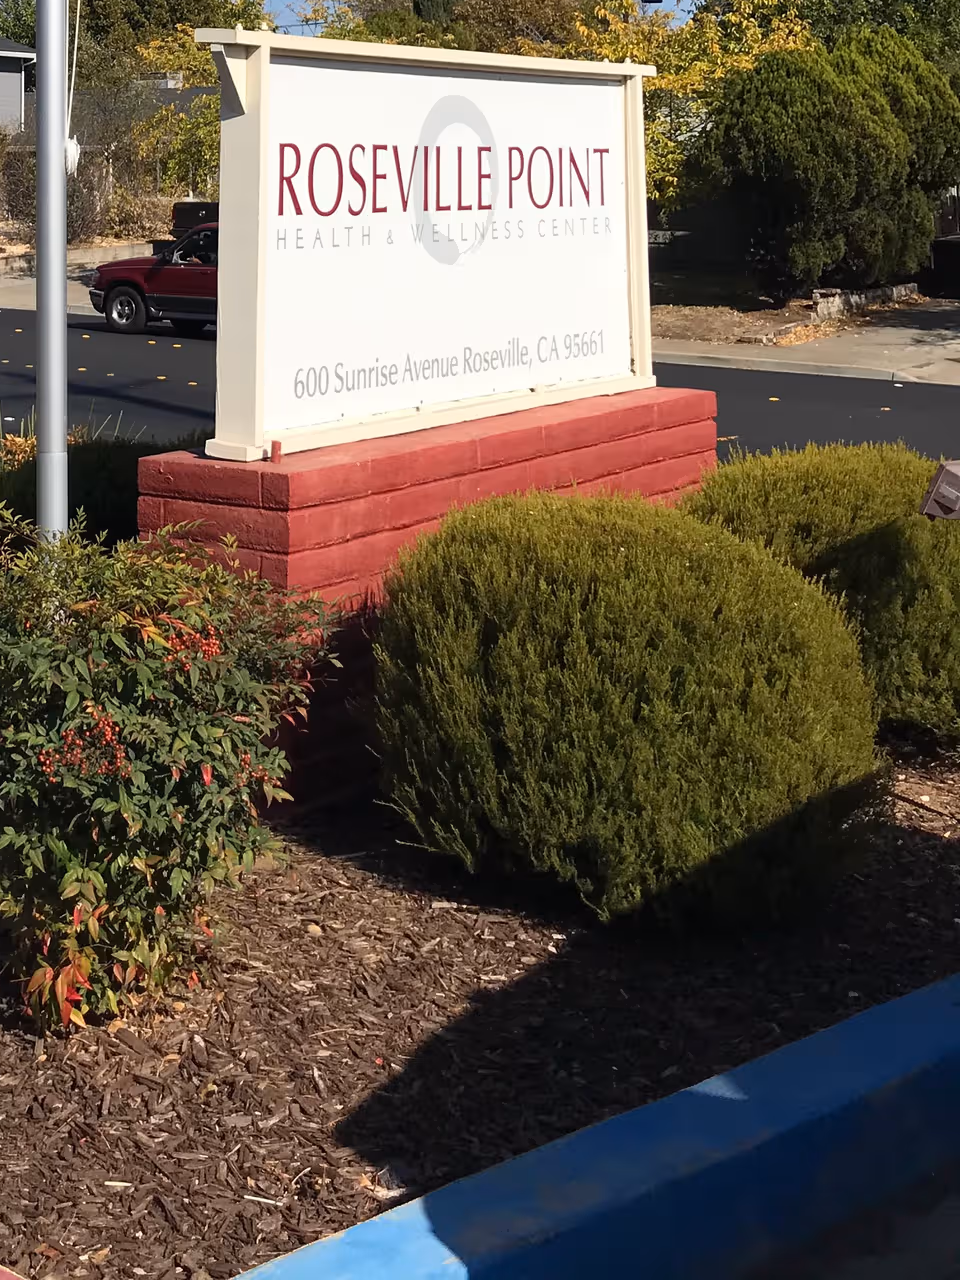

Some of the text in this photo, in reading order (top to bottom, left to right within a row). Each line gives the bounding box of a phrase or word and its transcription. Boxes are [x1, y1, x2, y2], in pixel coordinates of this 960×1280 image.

[277, 143, 610, 216] ROSEVILLE POINT
[276, 217, 612, 250] HEALTH & WELLNESS CENTER
[294, 329, 604, 399] 600 Sunrise Avenue Roseville, CA 95661
